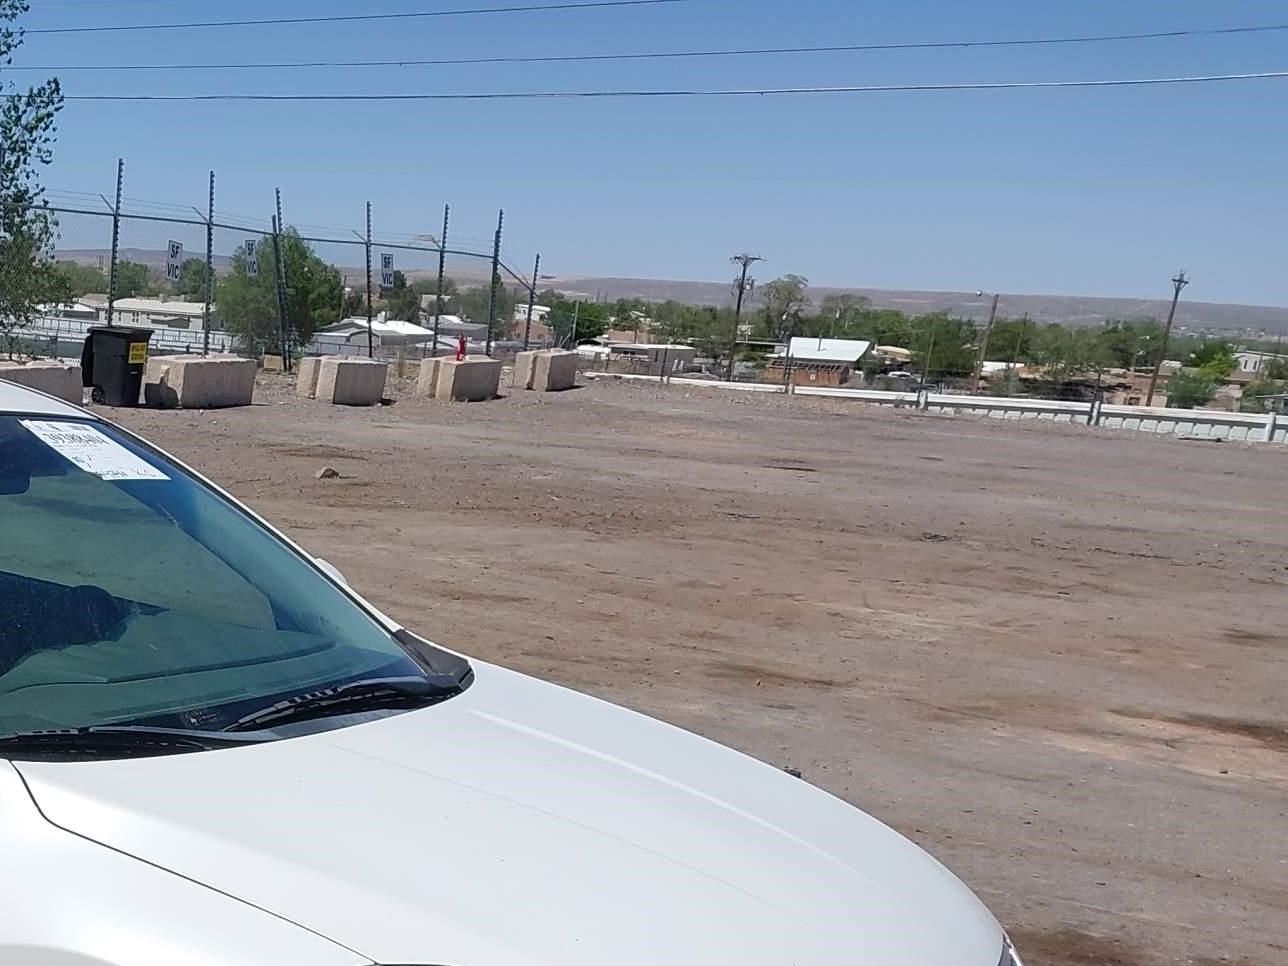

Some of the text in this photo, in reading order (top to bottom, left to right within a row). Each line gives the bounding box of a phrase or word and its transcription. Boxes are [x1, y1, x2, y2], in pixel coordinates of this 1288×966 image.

[170, 243, 180, 259] SF
[383, 255, 391, 269] SF
[167, 261, 179, 279] VIC
[382, 271, 393, 285] VIC
